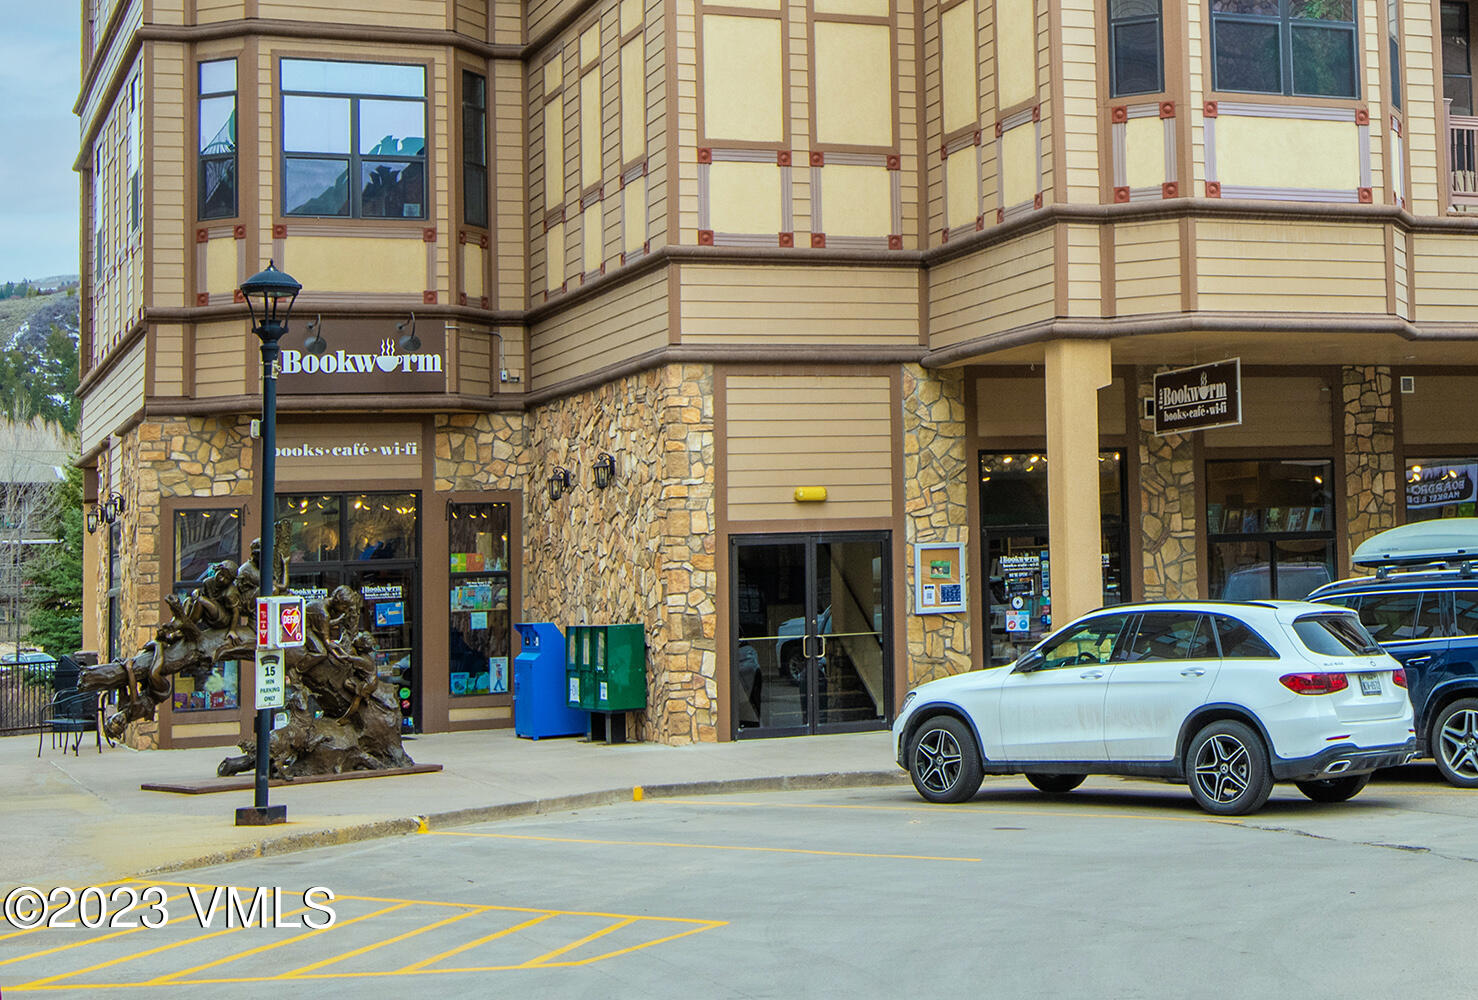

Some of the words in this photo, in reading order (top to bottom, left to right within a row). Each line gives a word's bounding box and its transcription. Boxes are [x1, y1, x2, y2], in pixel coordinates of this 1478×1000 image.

[280, 349, 443, 375] Bookworm
[1163, 382, 1228, 406] Bookworm
[1164, 408, 1187, 422] books
[1209, 401, 1227, 415] wi-fi
[331, 442, 370, 457] café
[379, 441, 418, 456] wi-fi
[265, 665, 276, 677] 15
